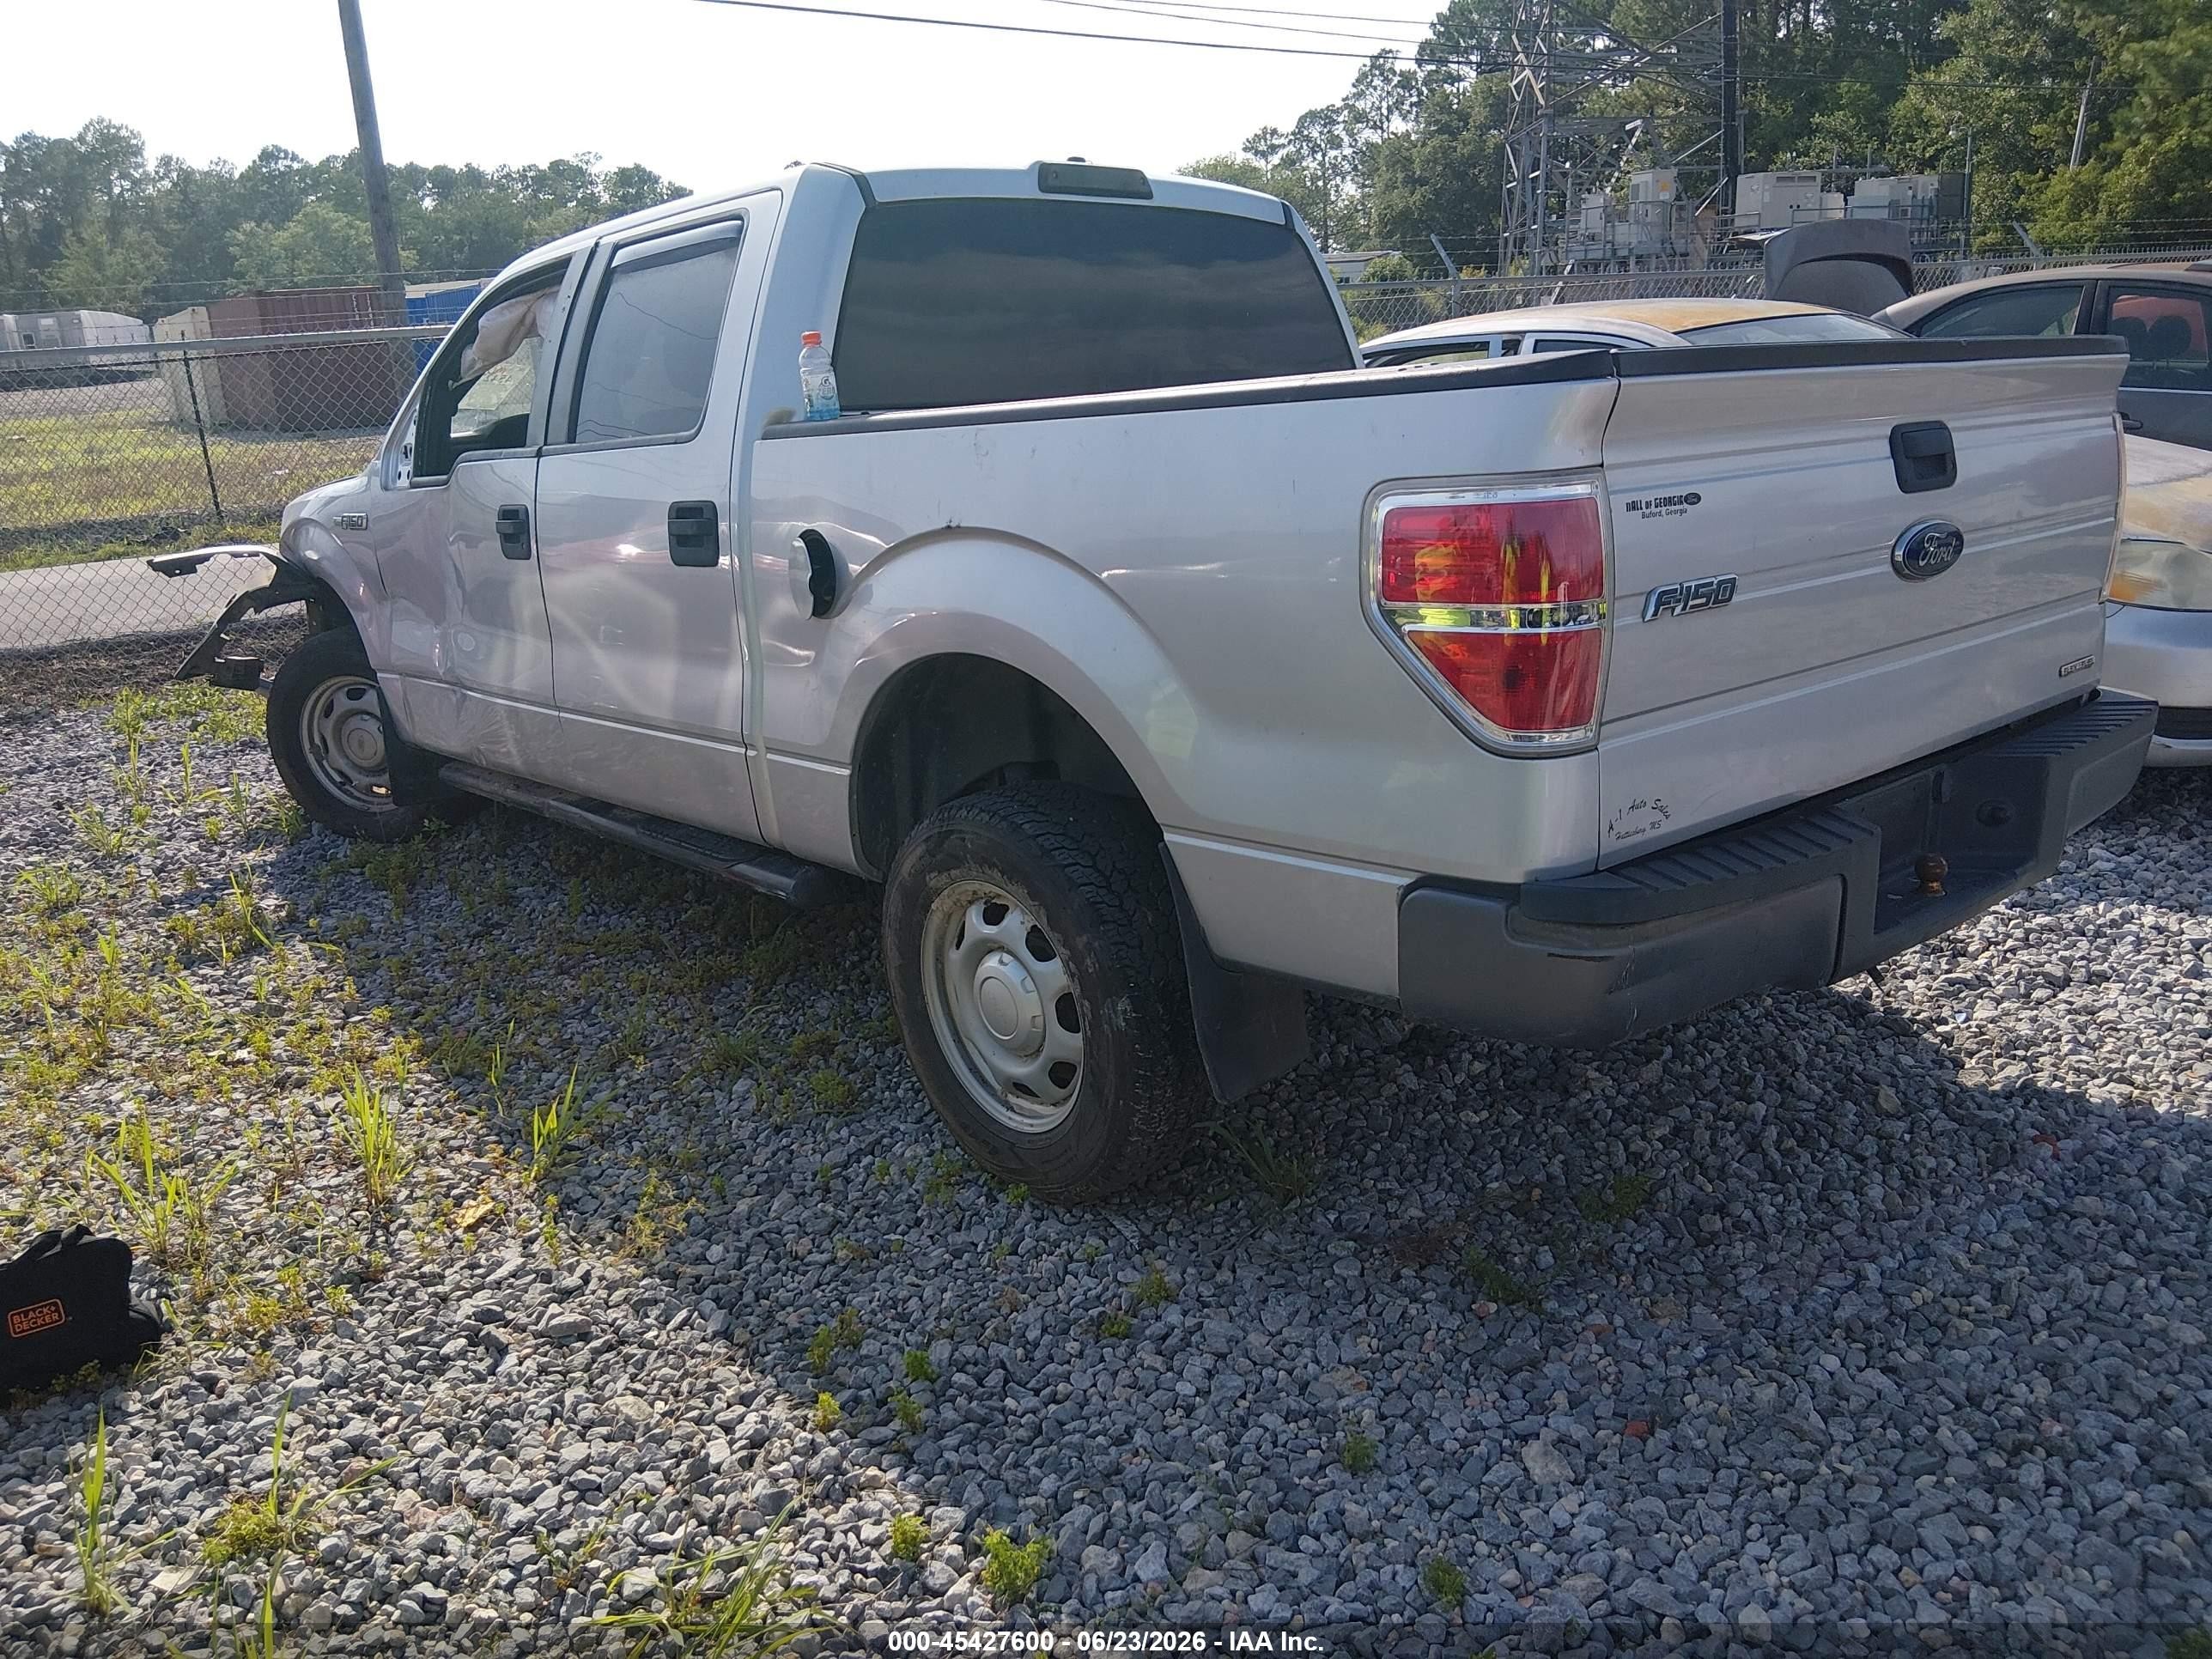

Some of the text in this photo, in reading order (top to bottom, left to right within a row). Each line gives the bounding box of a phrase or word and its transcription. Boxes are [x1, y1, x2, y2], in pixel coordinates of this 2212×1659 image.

[1644, 500, 1653, 510] OF
[1654, 495, 1684, 508] GEORGIA
[1641, 505, 1687, 520] Buford, Georgia
[1918, 532, 1956, 567] Ford
[1627, 798, 1647, 816] Auto
[15, 1312, 59, 1333] DECKER
